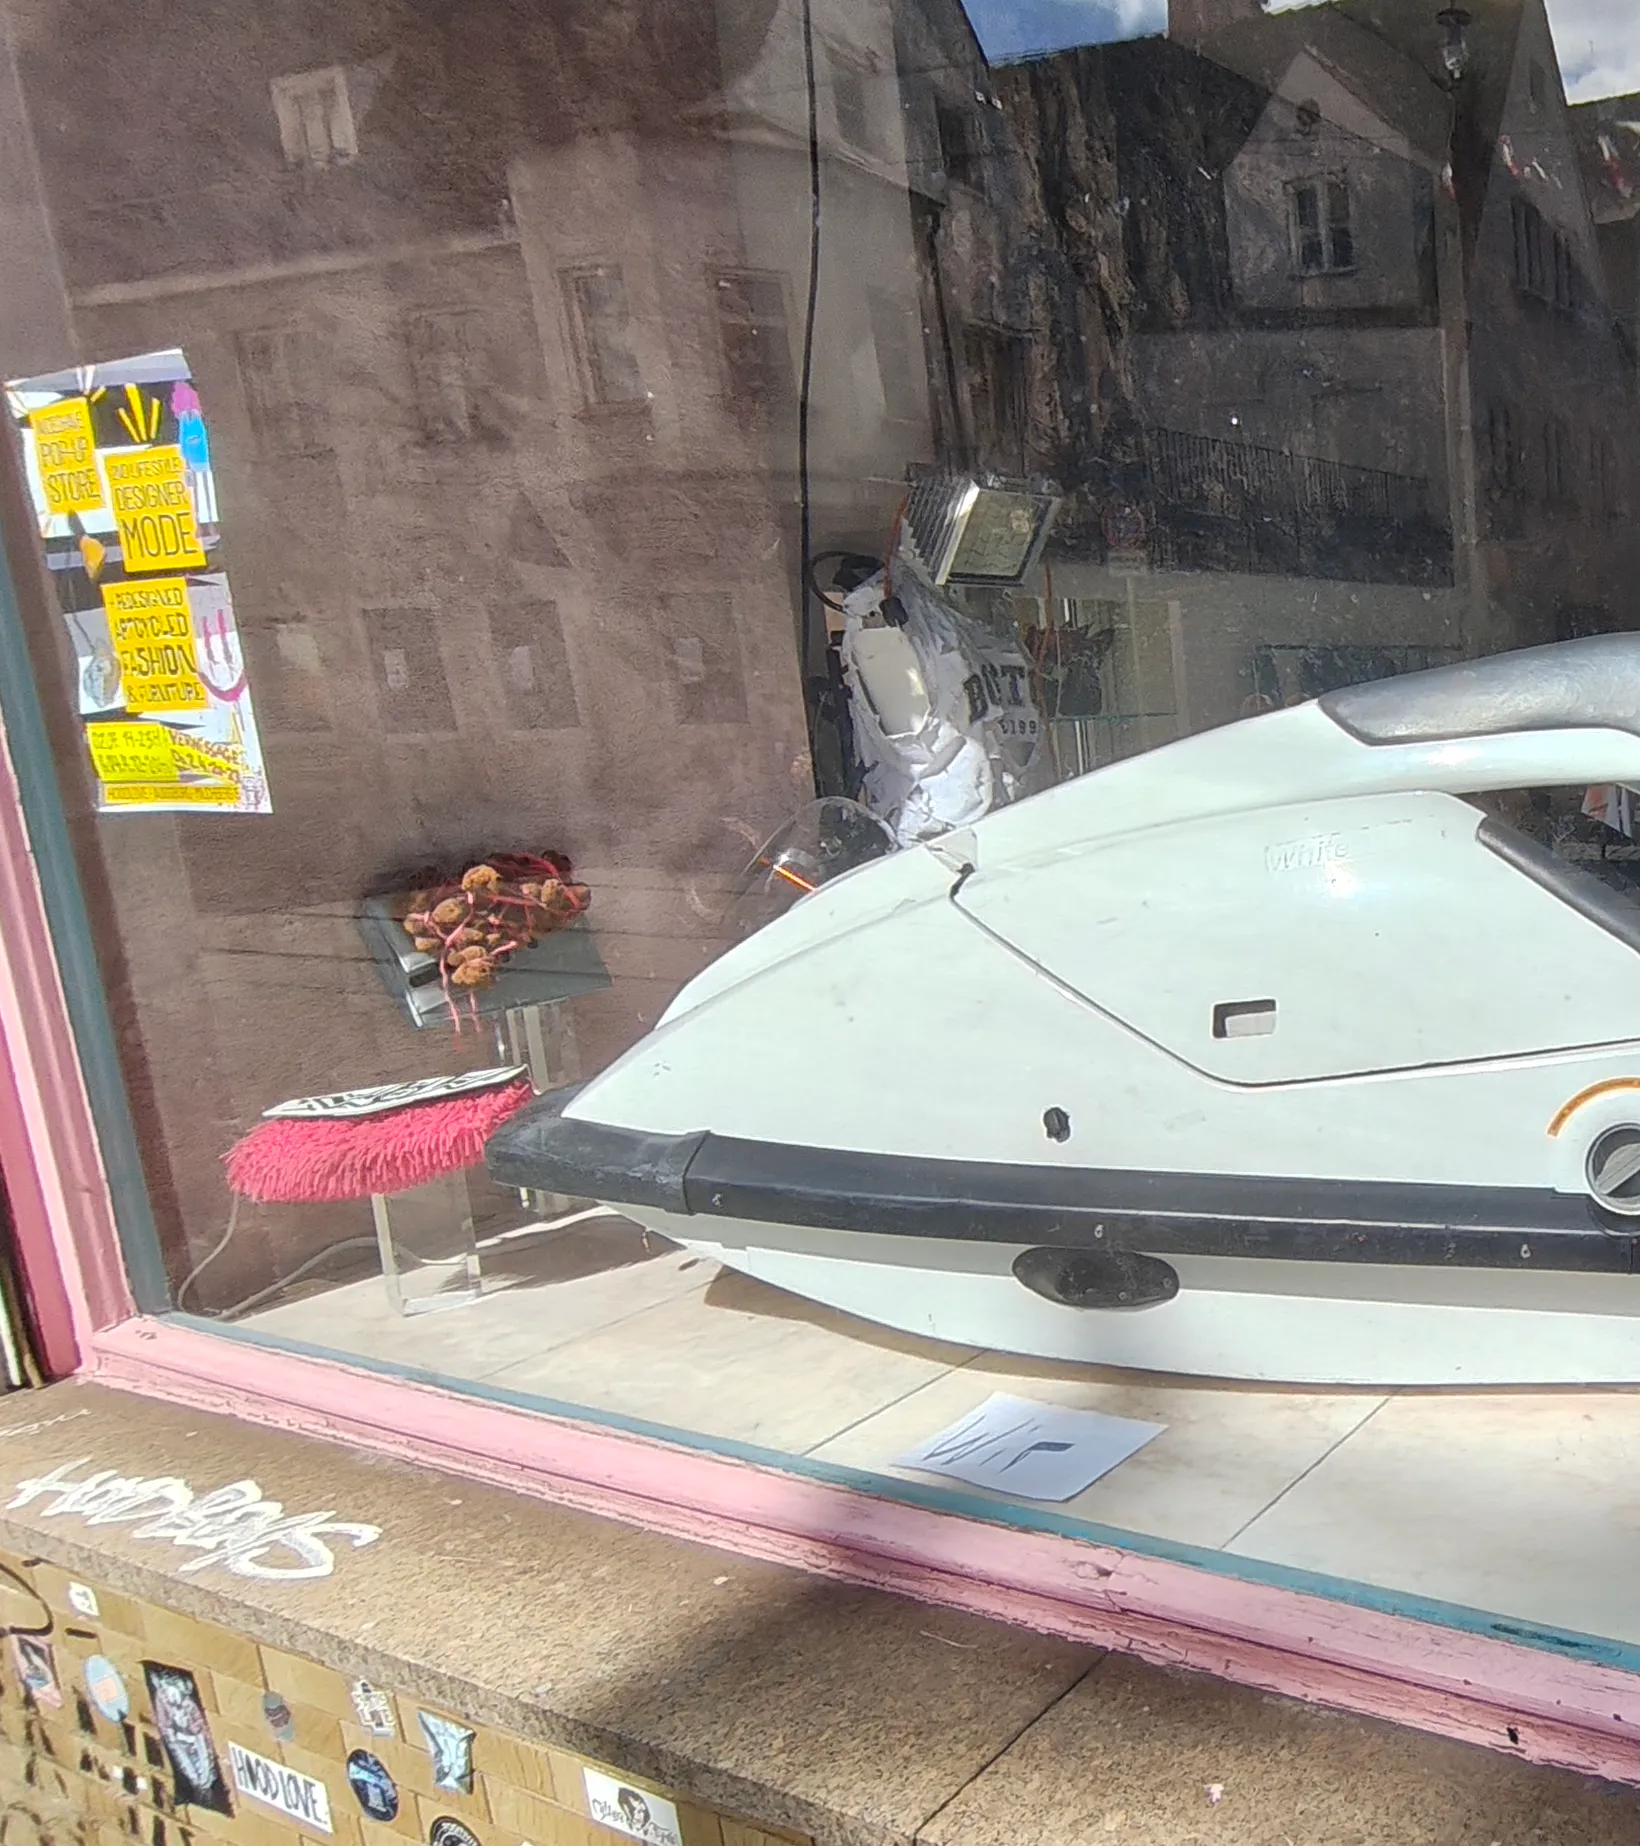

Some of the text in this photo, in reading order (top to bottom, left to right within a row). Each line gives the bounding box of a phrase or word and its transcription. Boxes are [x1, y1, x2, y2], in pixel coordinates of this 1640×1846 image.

[47, 468, 101, 503] STORE
[115, 480, 188, 511] DESIGNER
[121, 512, 199, 560] MODE
[121, 643, 197, 677] FASHION
